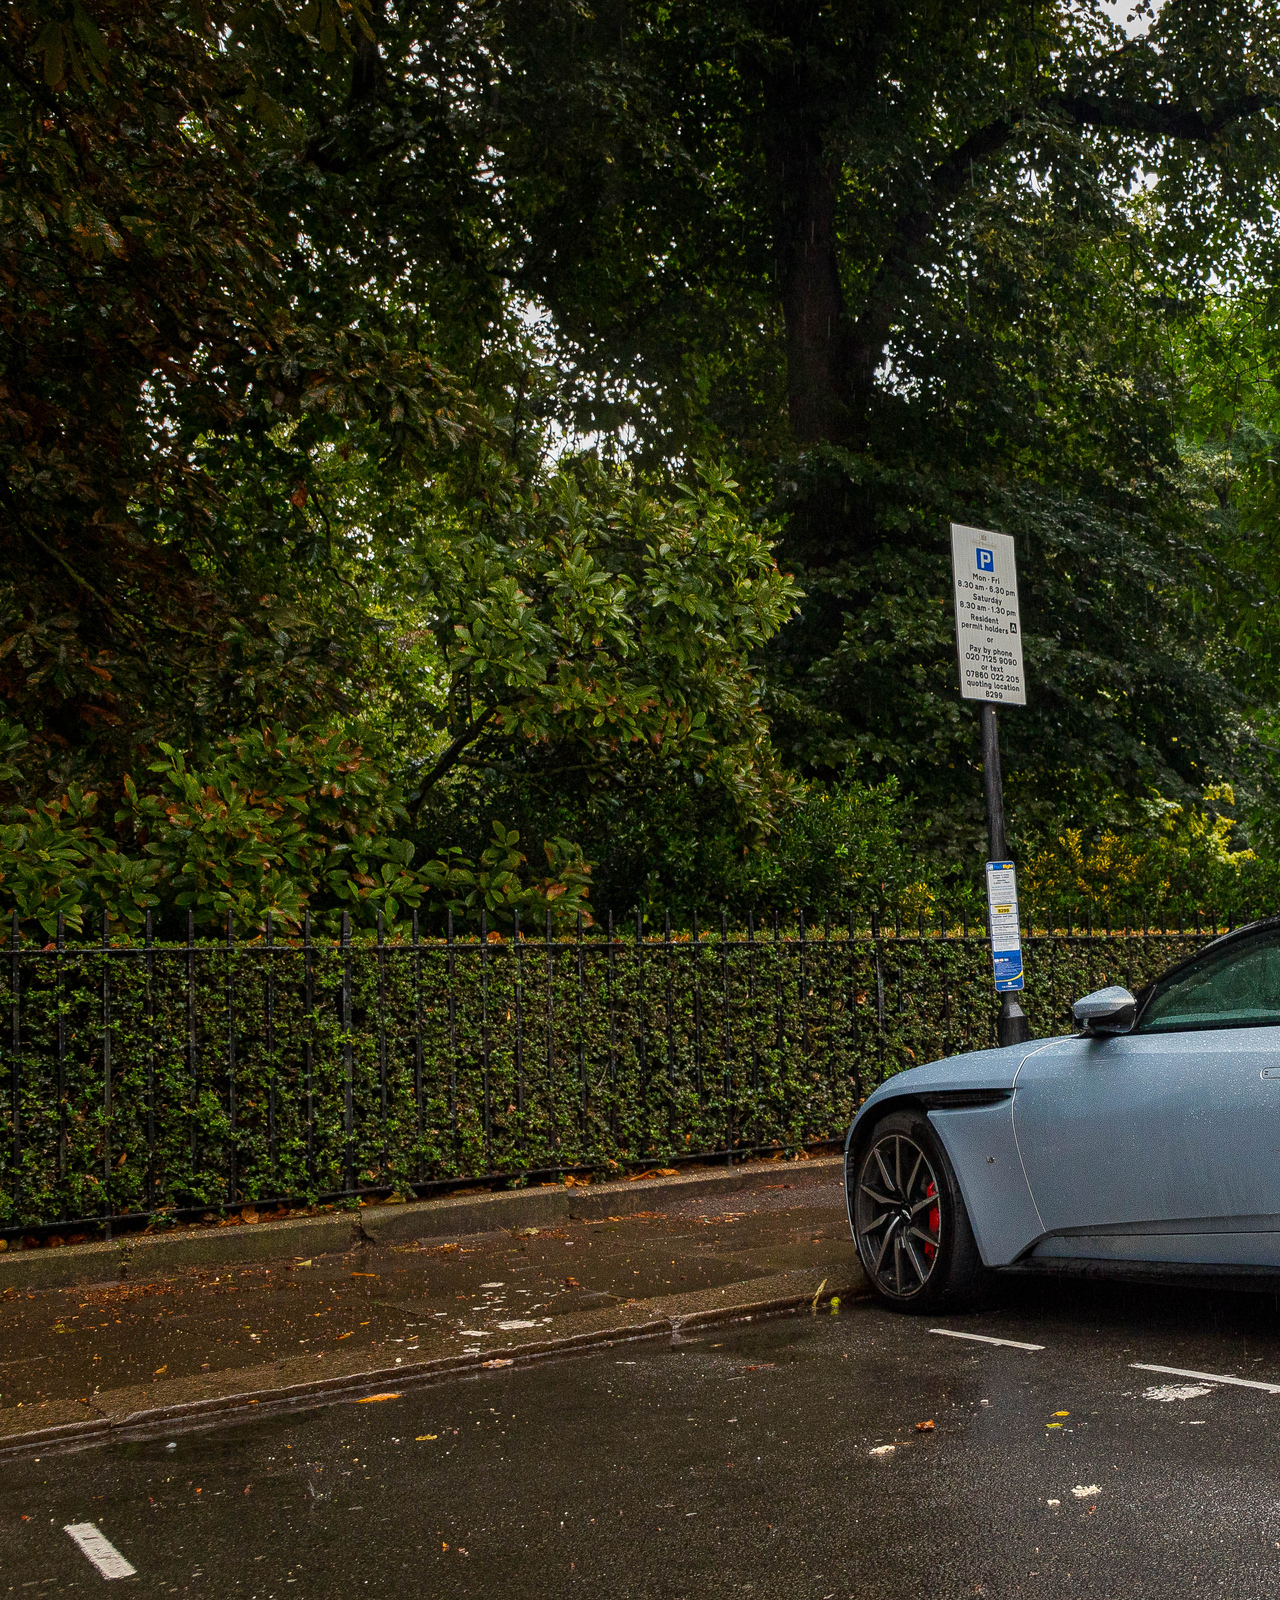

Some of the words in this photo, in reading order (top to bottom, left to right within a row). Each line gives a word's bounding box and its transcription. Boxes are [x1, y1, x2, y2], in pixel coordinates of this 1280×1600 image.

[980, 551, 991, 569] P
[972, 573, 987, 582] Mon
[991, 576, 1000, 585] Fri
[957, 580, 974, 589] 8.30
[989, 586, 1005, 595] 6.30
[1006, 590, 1016, 598] pm
[972, 593, 1003, 606] Saturday
[959, 600, 976, 610] 8.30
[991, 606, 1005, 615] 1.30
[1006, 610, 1017, 618] pm
[970, 613, 999, 625] Resident
[961, 621, 983, 631] permit
[984, 624, 1009, 635] holders
[969, 644, 981, 653] Pay
[983, 646, 991, 655] by
[993, 648, 1013, 657] phone
[965, 652, 980, 661] 020
[981, 655, 998, 664] 7125
[990, 664, 1004, 673] text
[990, 673, 1004, 681] 022
[1005, 675, 1020, 684] 205
[966, 680, 992, 690] quoting
[993, 683, 1020, 692] location
[985, 690, 1003, 699] 8299
